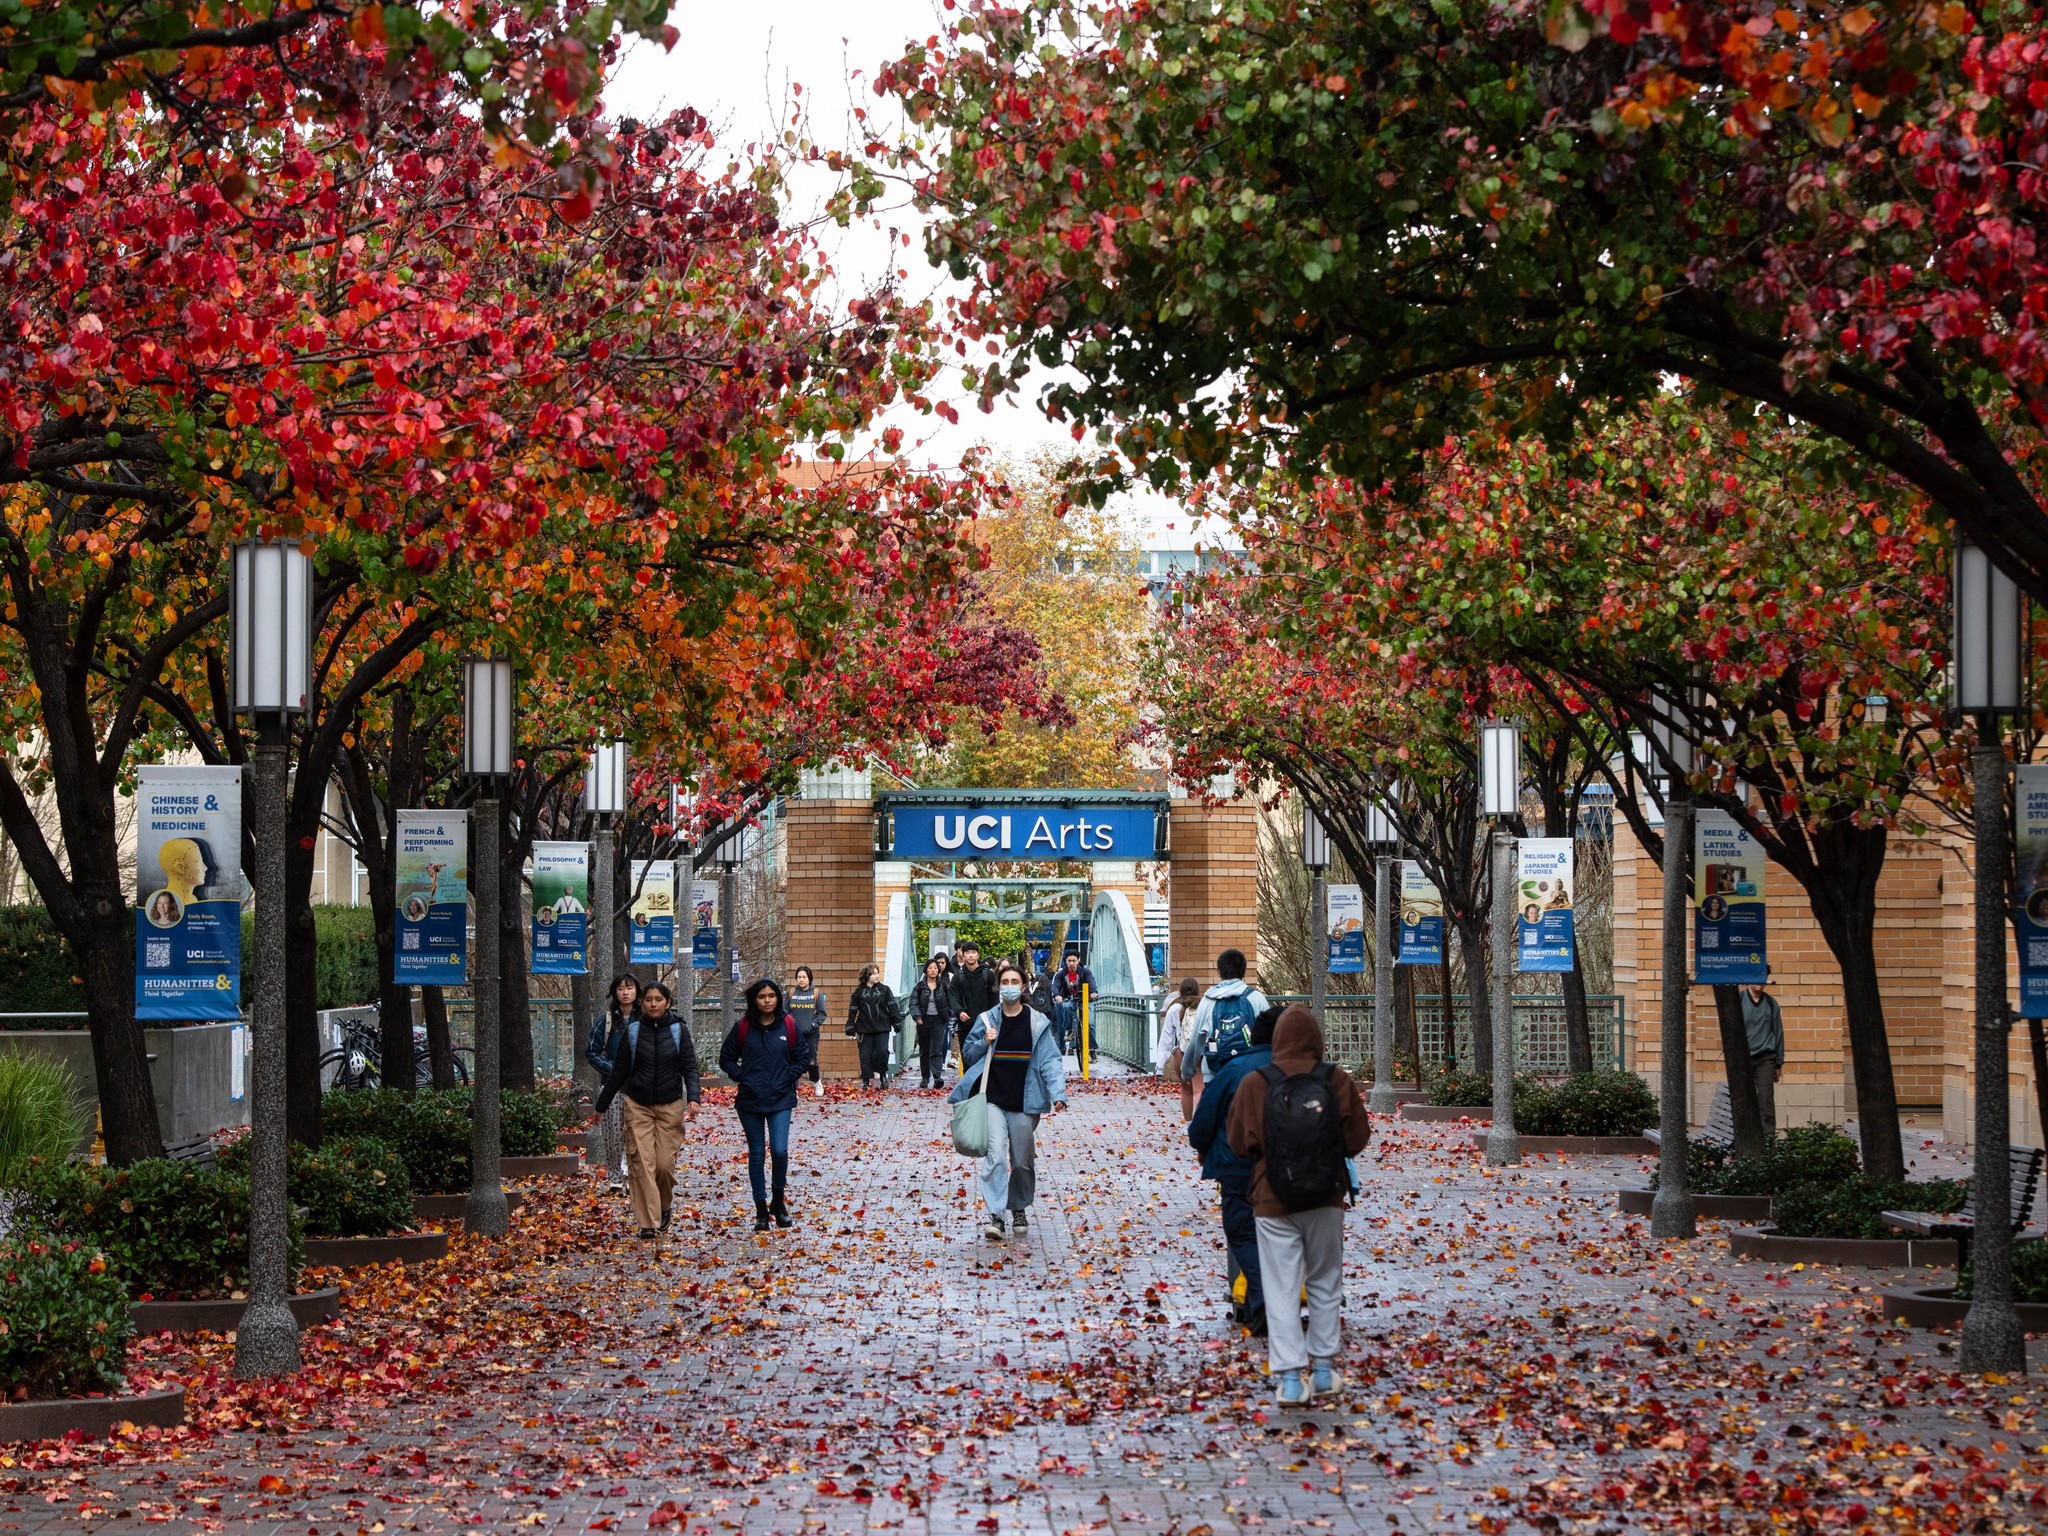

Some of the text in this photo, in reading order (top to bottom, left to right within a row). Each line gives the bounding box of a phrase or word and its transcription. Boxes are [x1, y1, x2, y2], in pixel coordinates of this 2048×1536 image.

[151, 794, 219, 811] CHINESE &
[151, 806, 199, 815] HISTORY
[151, 822, 206, 830] MEDICINE
[437, 826, 444, 835] &
[934, 815, 1114, 850] UCI Arts
[1703, 829, 1749, 841] MEDIA &
[1558, 853, 1567, 863] &
[646, 892, 670, 910] 12
[187, 950, 204, 958] UCI
[573, 951, 582, 960] &
[1560, 947, 1569, 956] &
[449, 953, 460, 964] &
[1750, 953, 1761, 964] &
[144, 974, 232, 990] HUMANITIES &
